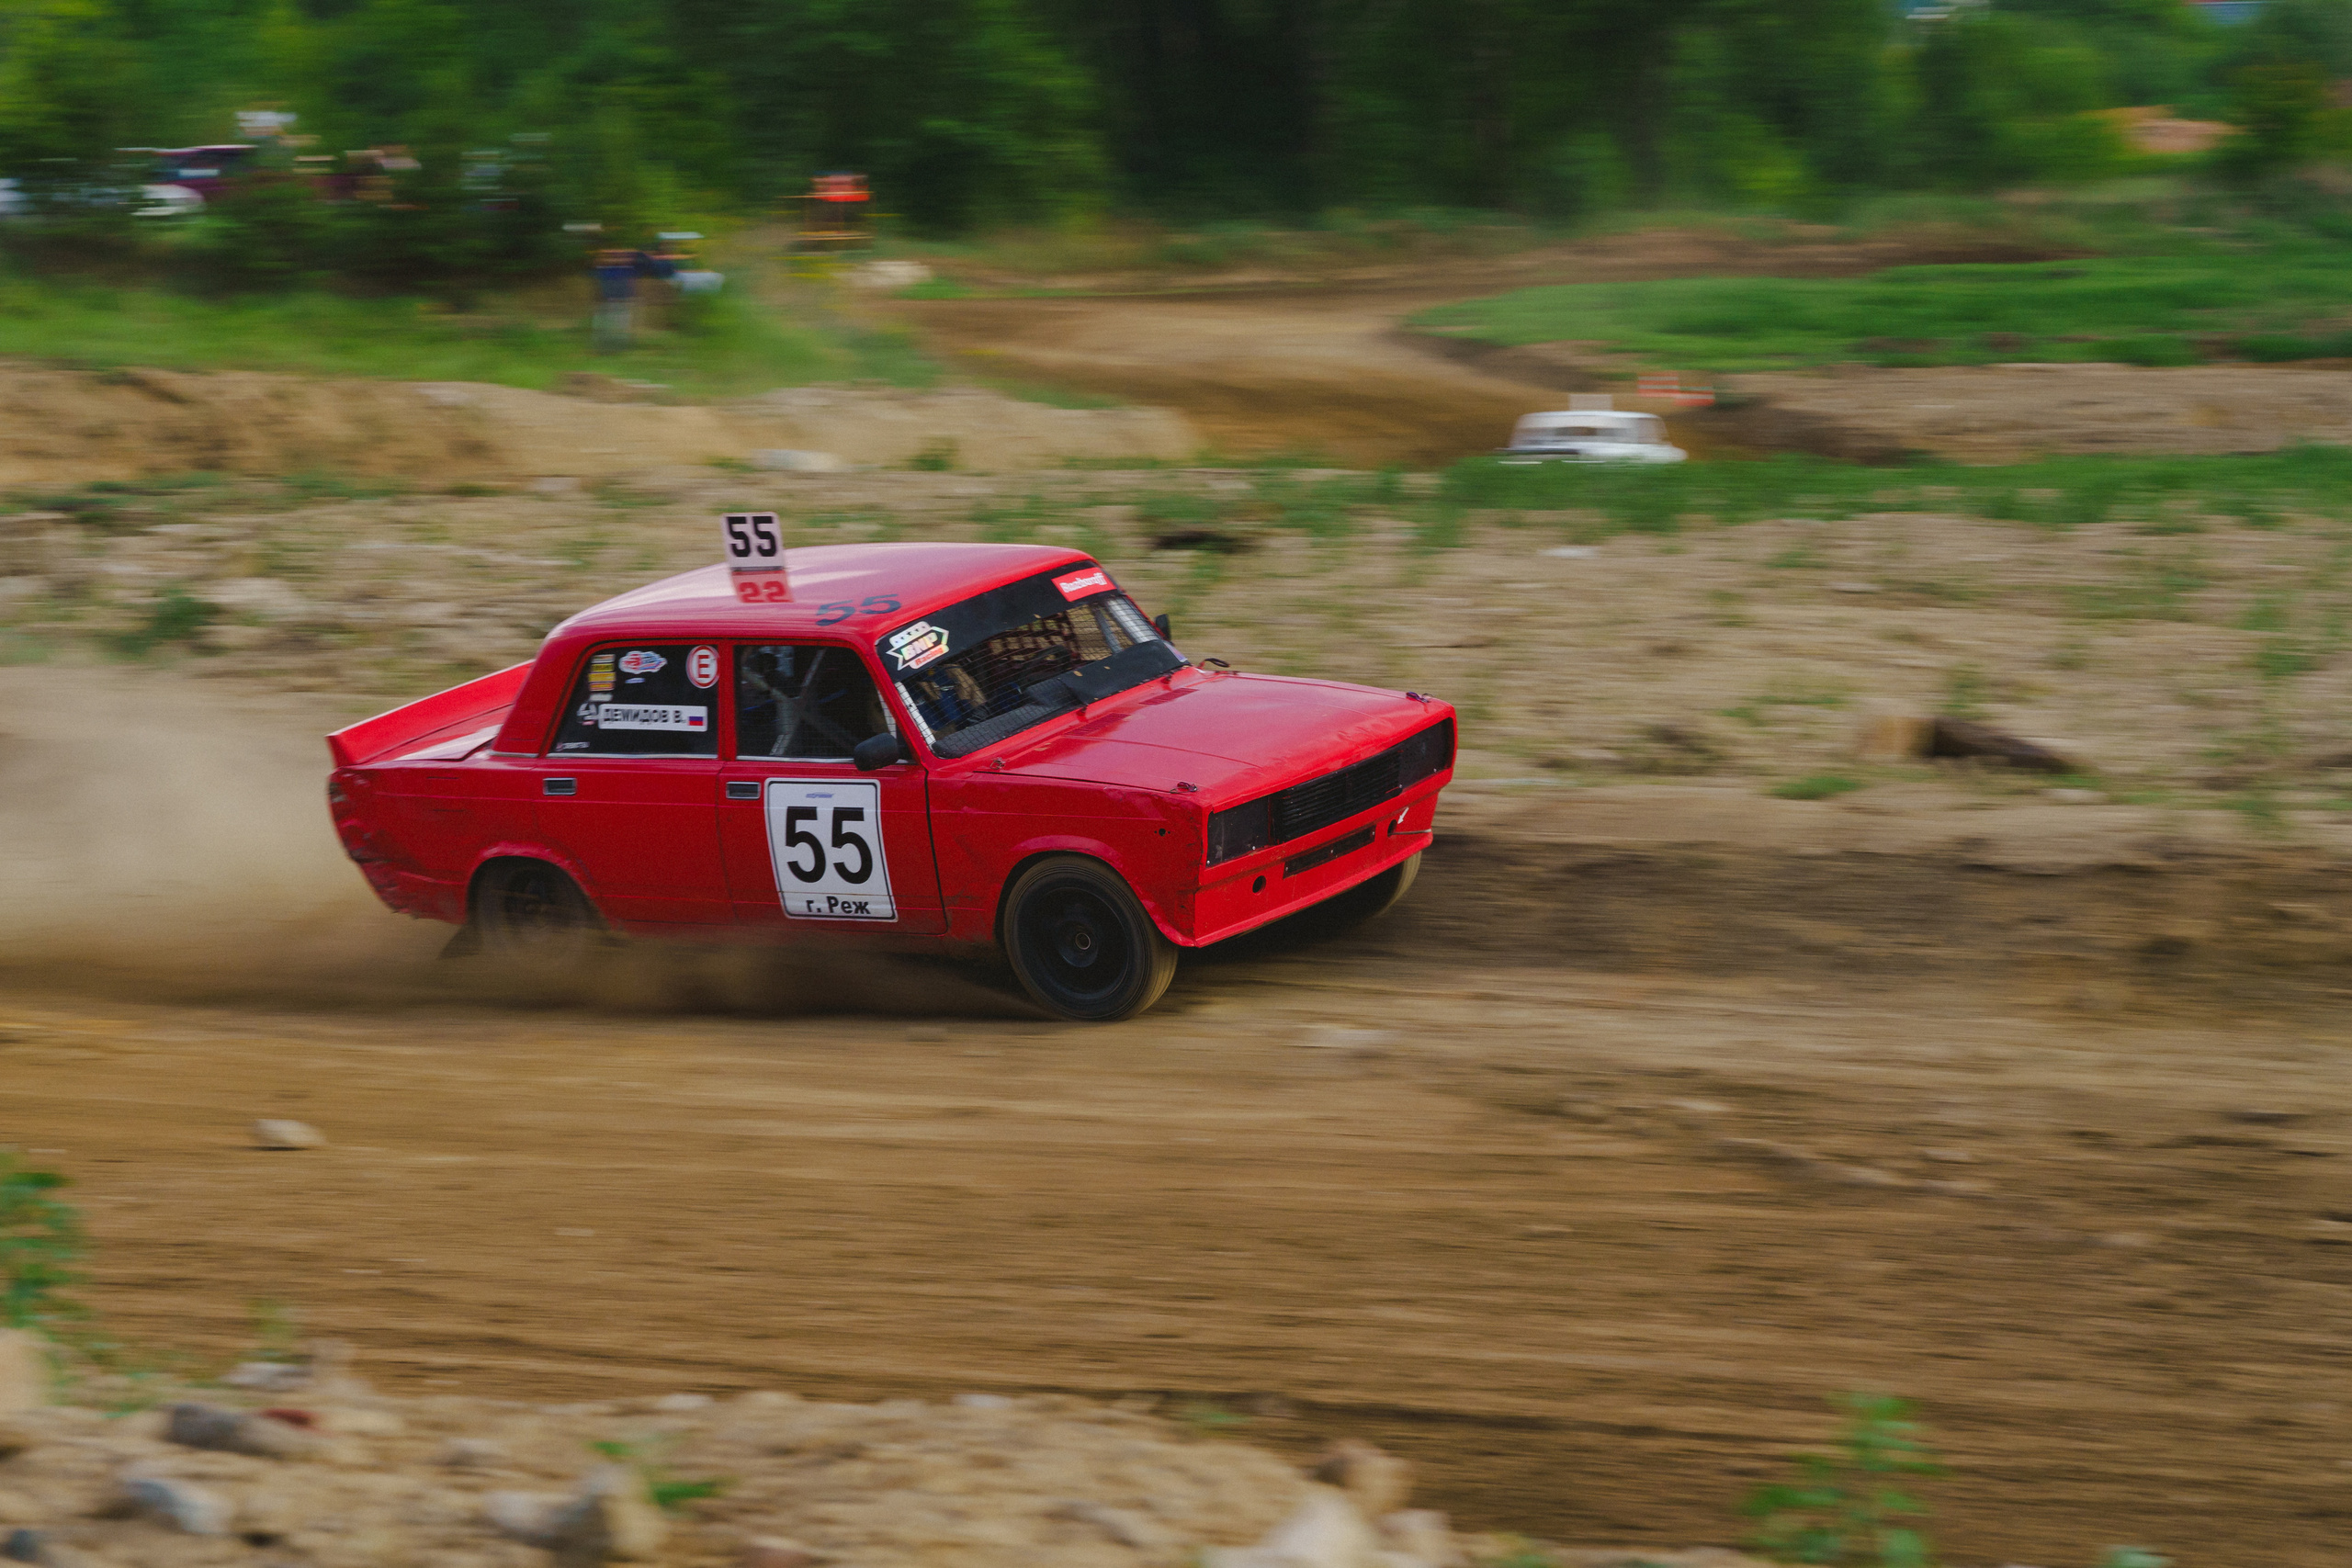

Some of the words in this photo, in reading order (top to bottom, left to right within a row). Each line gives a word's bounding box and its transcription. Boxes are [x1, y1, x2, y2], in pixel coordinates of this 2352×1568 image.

[726, 515, 777, 558] 55
[815, 593, 901, 627] 55
[697, 654, 710, 679] E
[604, 708, 669, 725] ДЕМИДОВ
[786, 806, 874, 885] 55
[806, 899, 822, 913] г.
[826, 896, 871, 915] Реж
